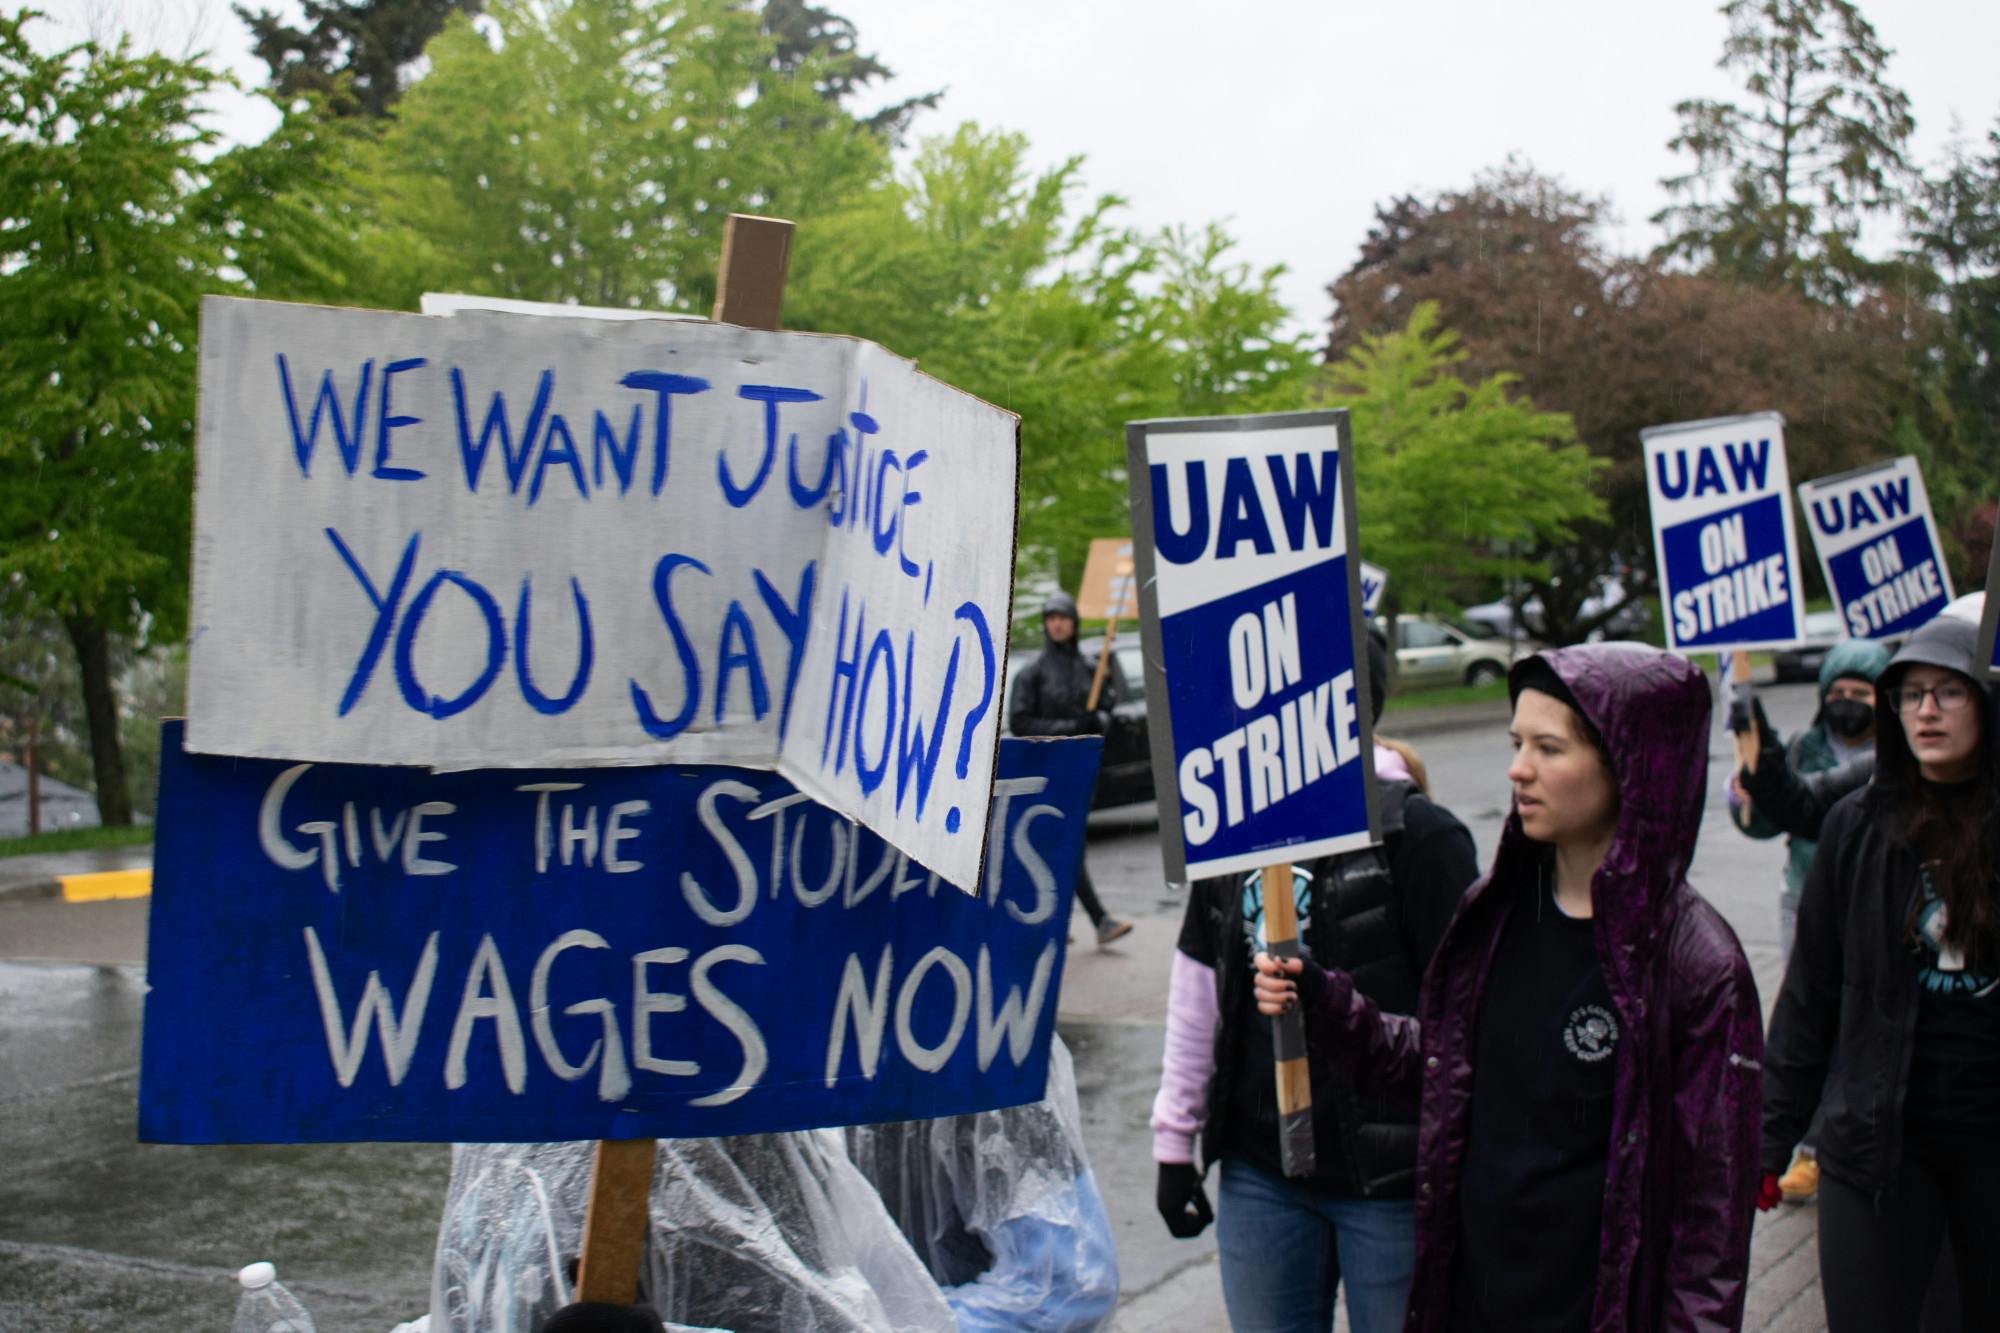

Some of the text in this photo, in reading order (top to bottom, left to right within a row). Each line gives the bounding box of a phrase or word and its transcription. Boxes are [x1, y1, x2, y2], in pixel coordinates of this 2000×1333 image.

[276, 352, 428, 481] WE
[449, 366, 711, 507] WANT
[1656, 438, 1769, 500] UAW
[1149, 450, 1339, 565] UAW
[1699, 512, 1748, 576] ON
[1812, 476, 1910, 535] UAW
[1860, 534, 1903, 587] ON
[1228, 592, 1301, 710] ON
[1673, 553, 1788, 641] STRIKE
[1846, 558, 1942, 638] STRIKE
[323, 527, 995, 834] YOU SAY HOW?
[1179, 668, 1360, 846] STRIKE
[258, 763, 1064, 927] GIVE THE STUDTS
[304, 925, 1057, 1107] WAGES NOW
